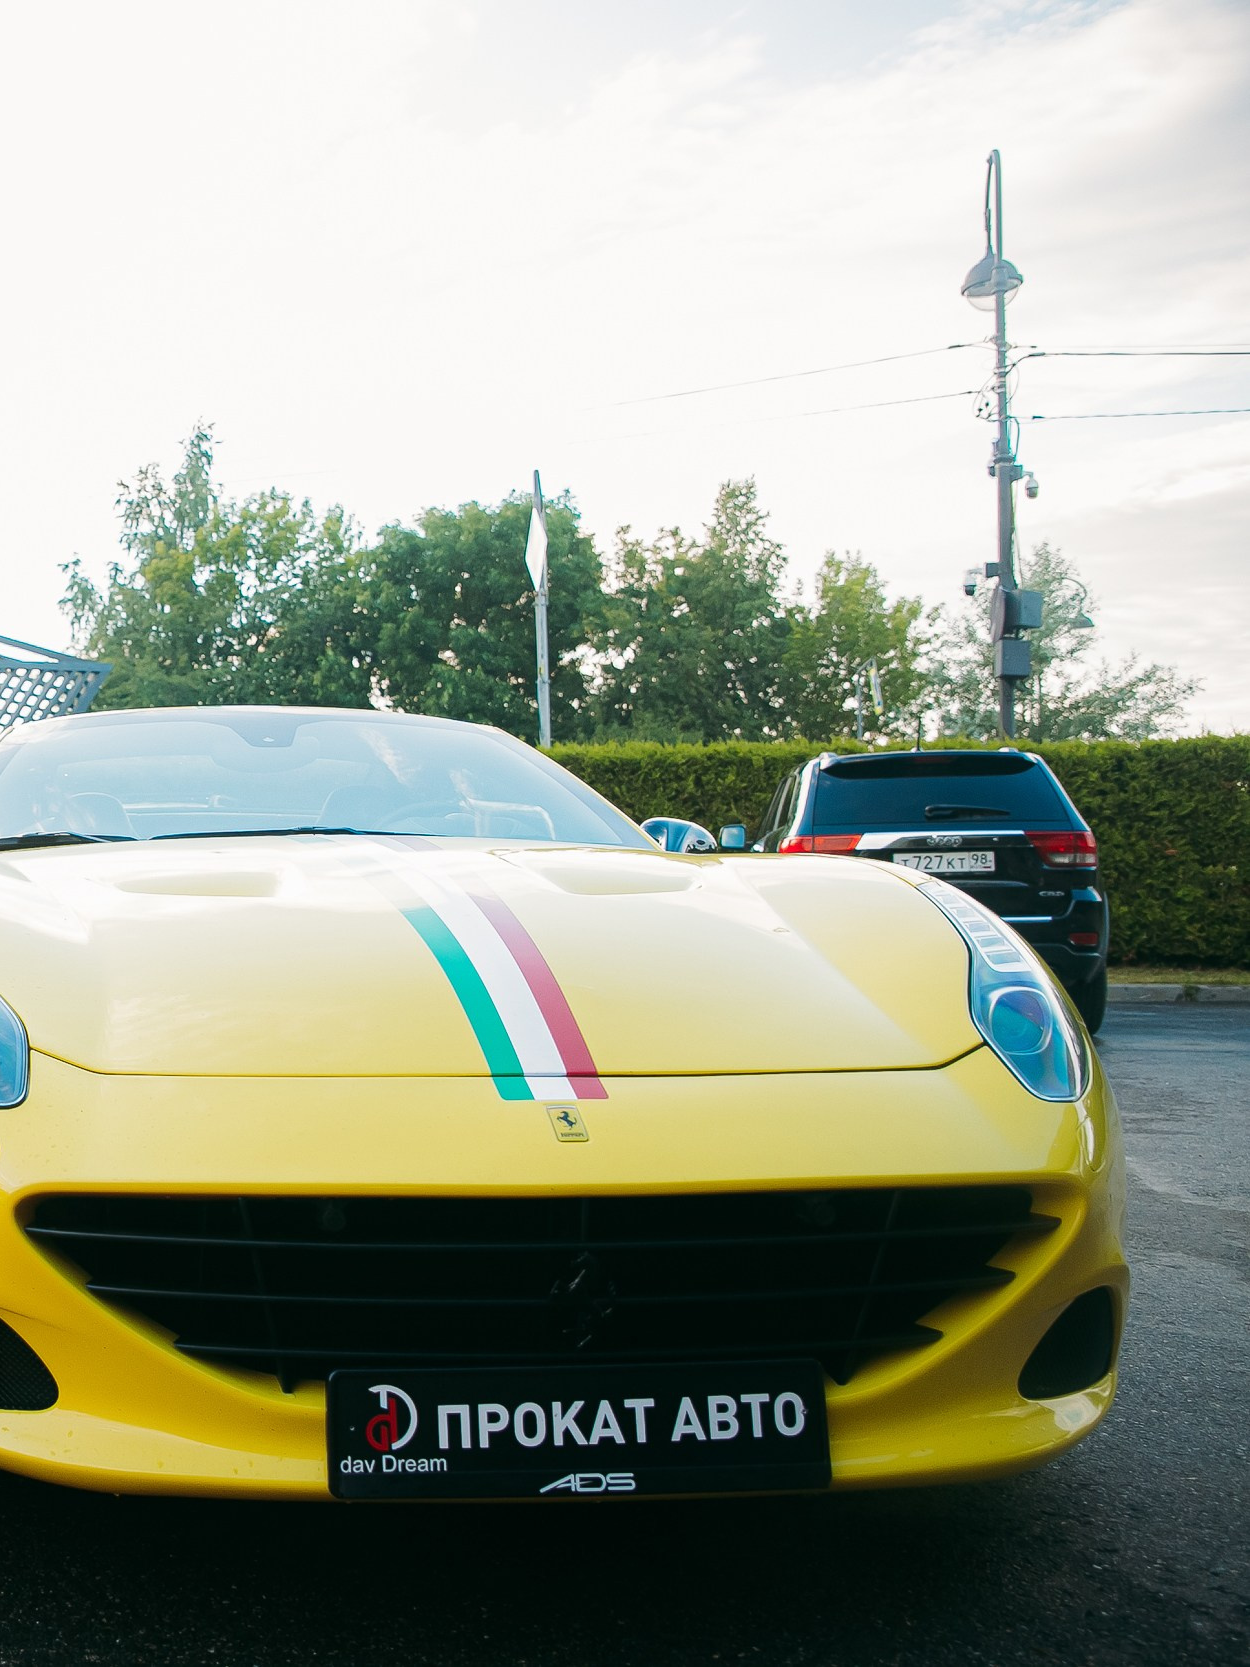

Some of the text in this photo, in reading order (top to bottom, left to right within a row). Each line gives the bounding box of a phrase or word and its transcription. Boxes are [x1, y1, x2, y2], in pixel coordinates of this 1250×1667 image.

[437, 1391, 807, 1449] ПРОКАТ АВТО
[382, 1454, 448, 1473] Dream
[539, 1472, 636, 1493] ADS
